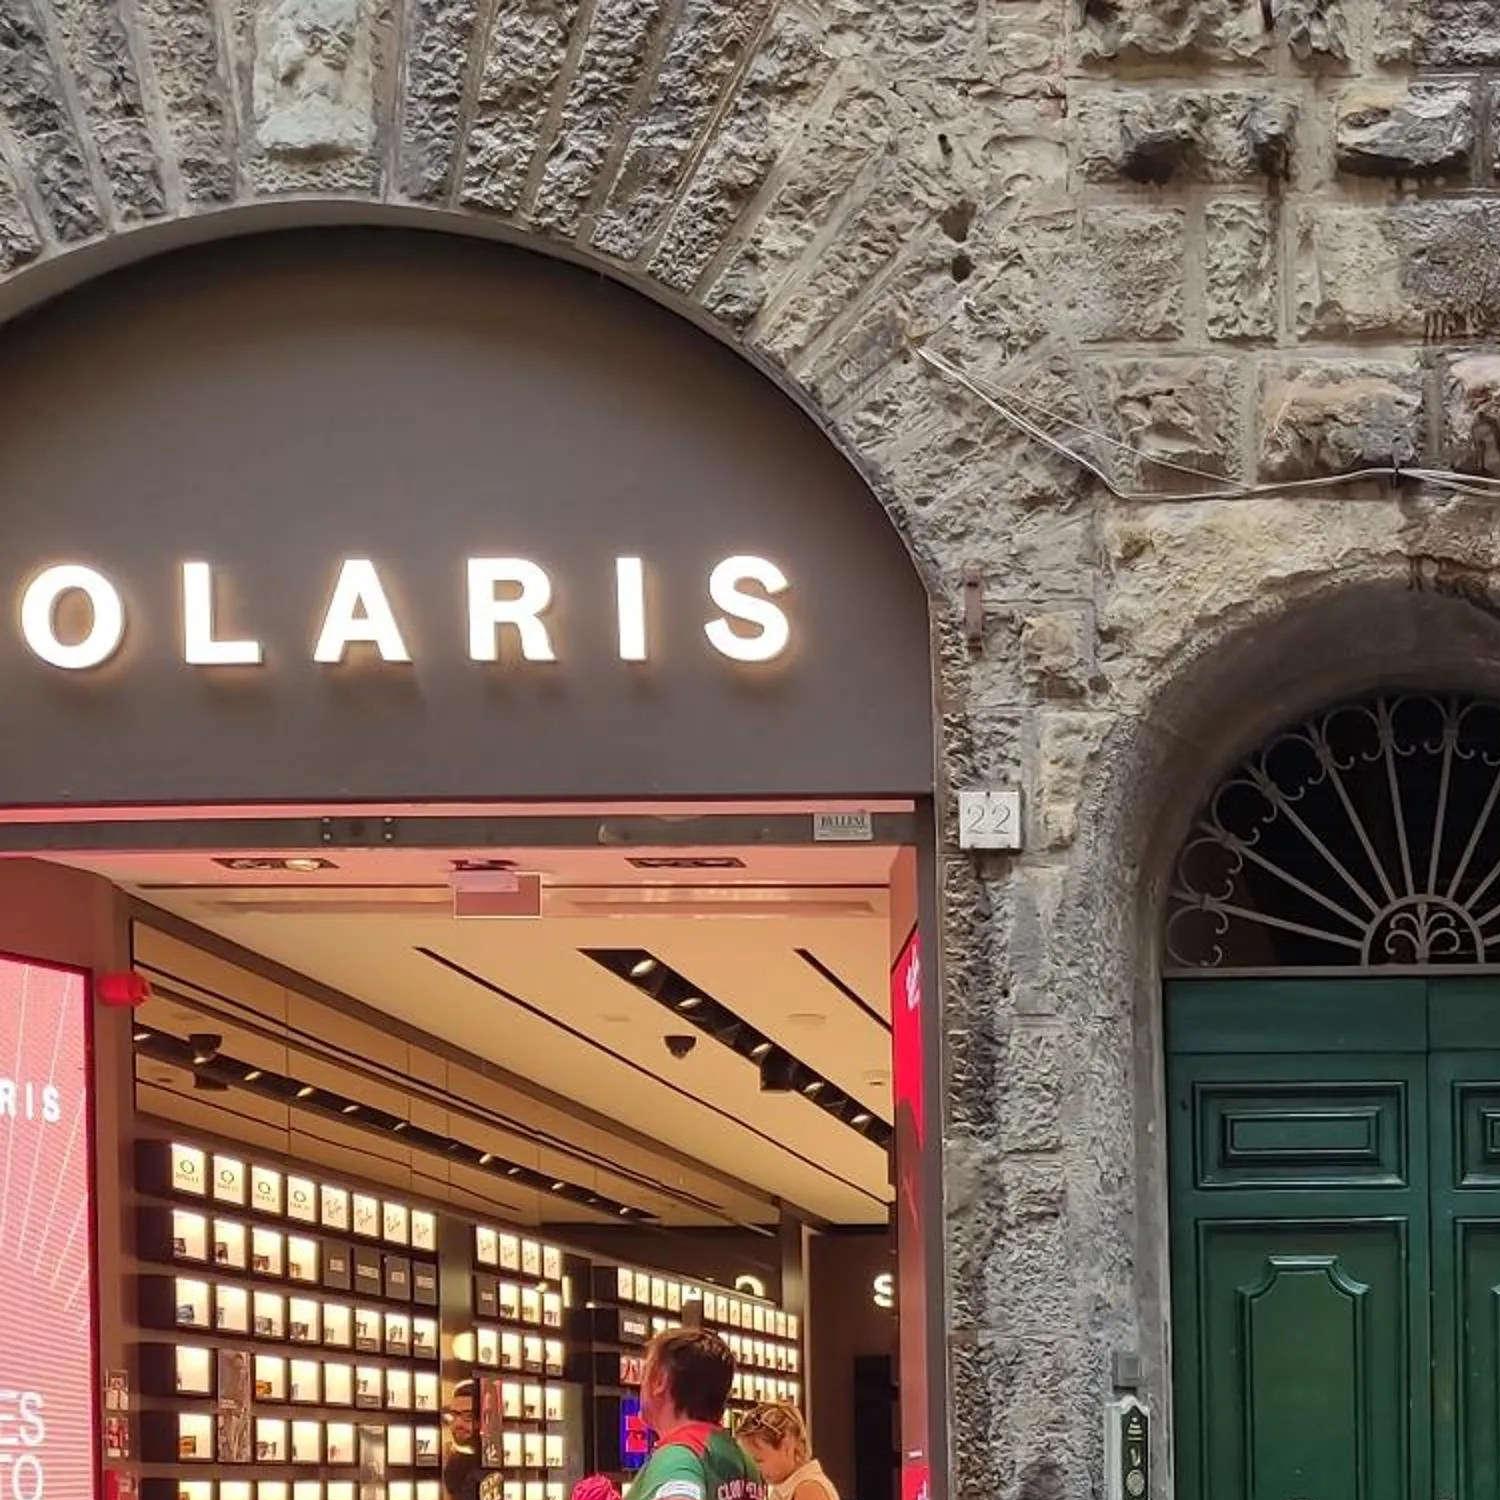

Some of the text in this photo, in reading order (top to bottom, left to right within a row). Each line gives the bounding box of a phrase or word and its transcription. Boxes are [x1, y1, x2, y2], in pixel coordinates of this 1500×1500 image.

[20, 554, 792, 670] OLARIS
[967, 805, 1011, 835] 22
[0, 1078, 60, 1122] RIS
